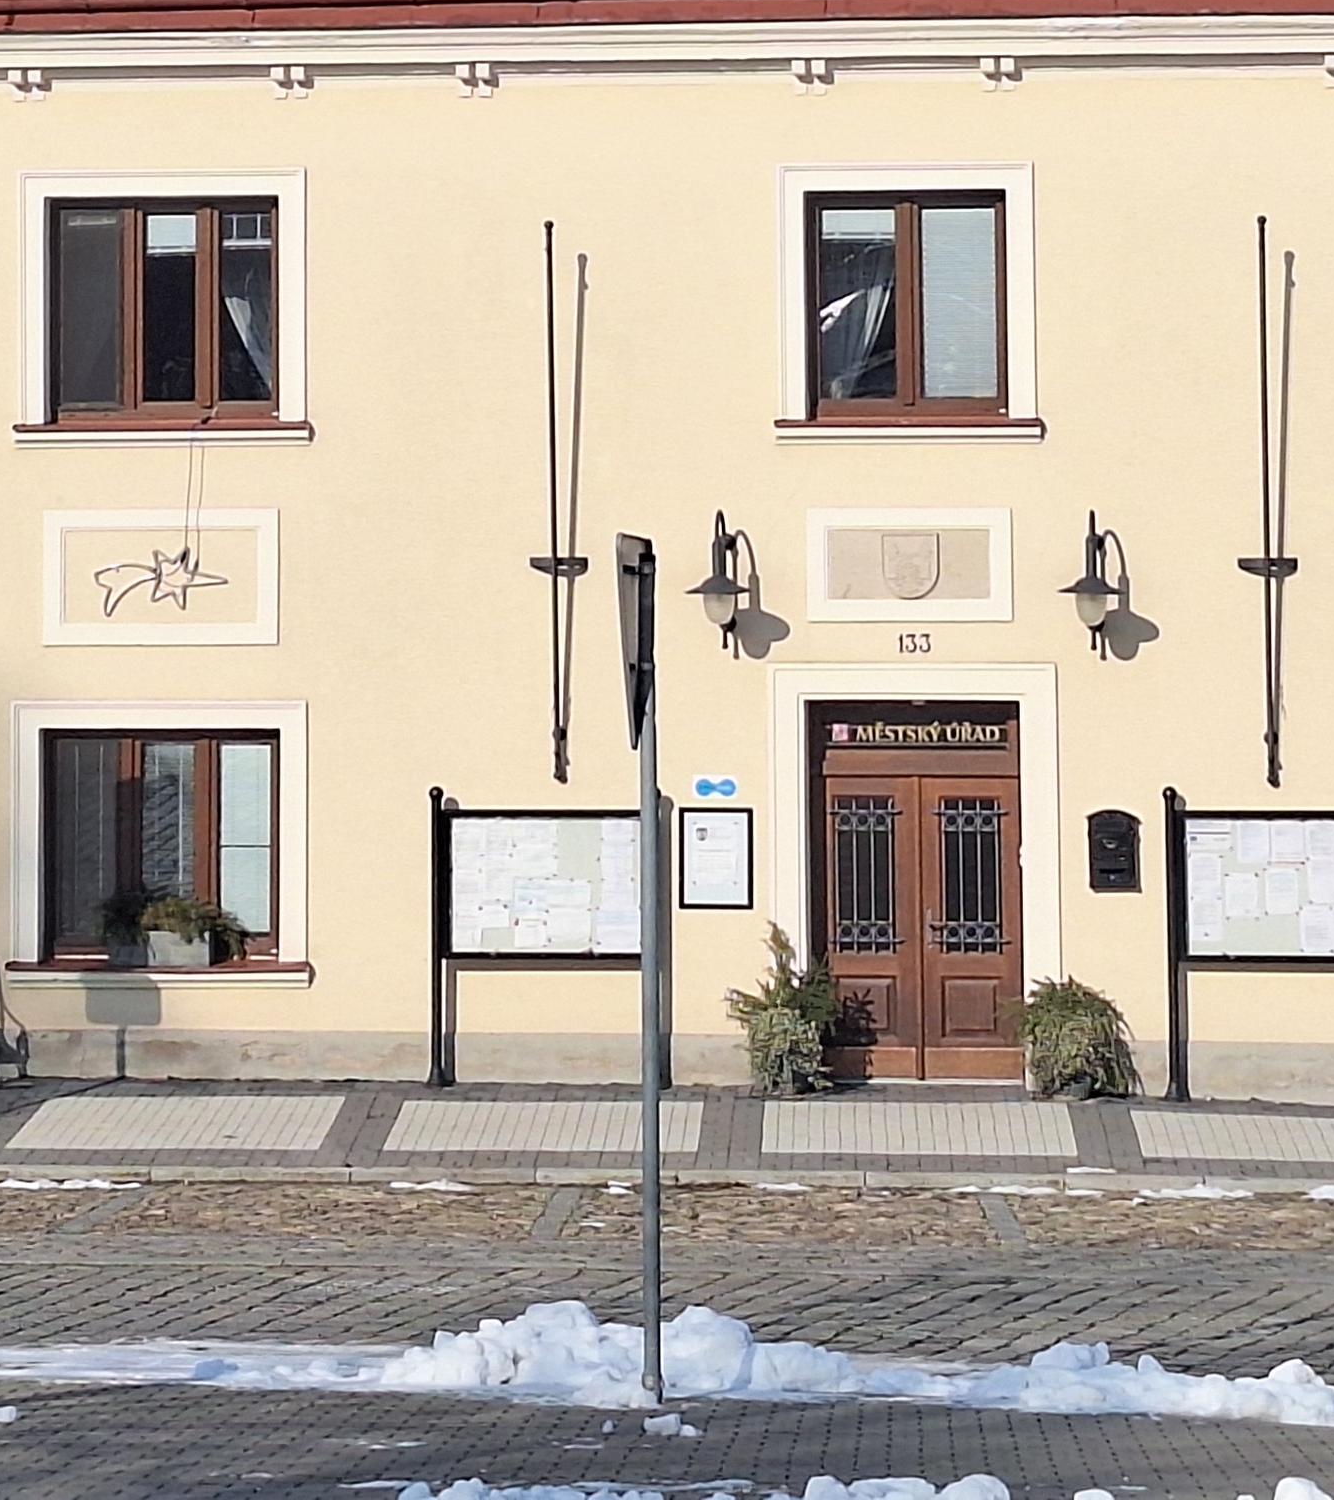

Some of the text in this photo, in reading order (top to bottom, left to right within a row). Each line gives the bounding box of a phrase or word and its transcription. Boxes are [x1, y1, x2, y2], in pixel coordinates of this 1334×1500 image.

[899, 633, 931, 654] 133
[856, 720, 1000, 742] MĚSTSKÝ ÚŘAD
